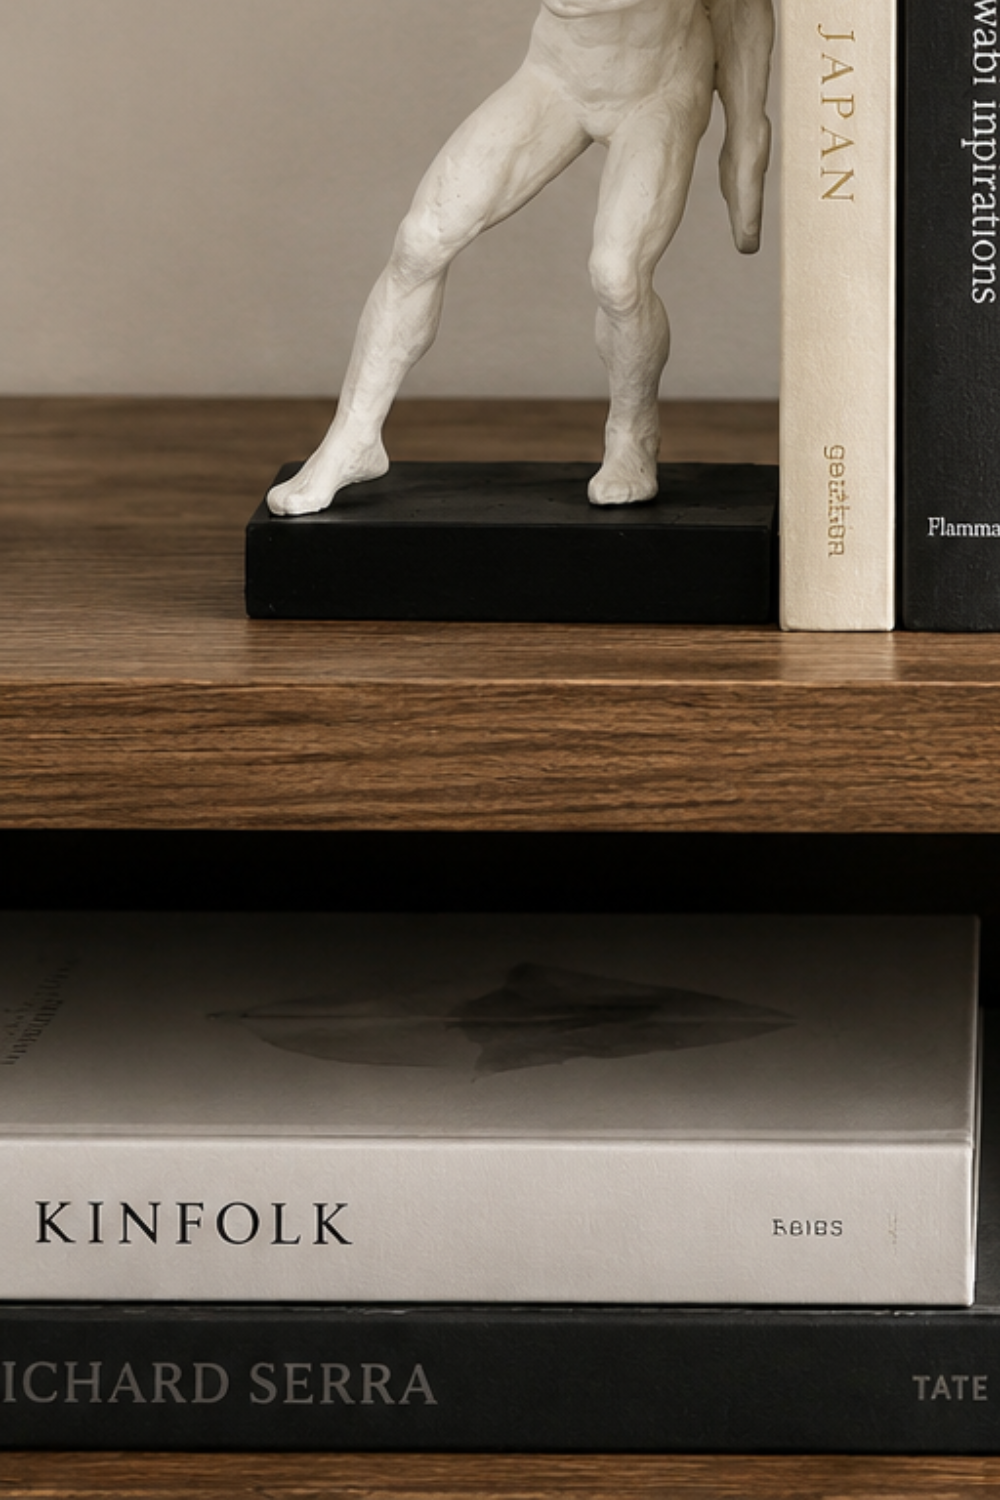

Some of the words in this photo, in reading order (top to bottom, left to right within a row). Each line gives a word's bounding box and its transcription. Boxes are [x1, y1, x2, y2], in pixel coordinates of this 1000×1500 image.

[817, 23, 855, 201] JAPAN
[35, 1201, 353, 1245] KINFOLK
[249, 1362, 438, 1405] SERRA
[912, 1374, 989, 1401] TATE
